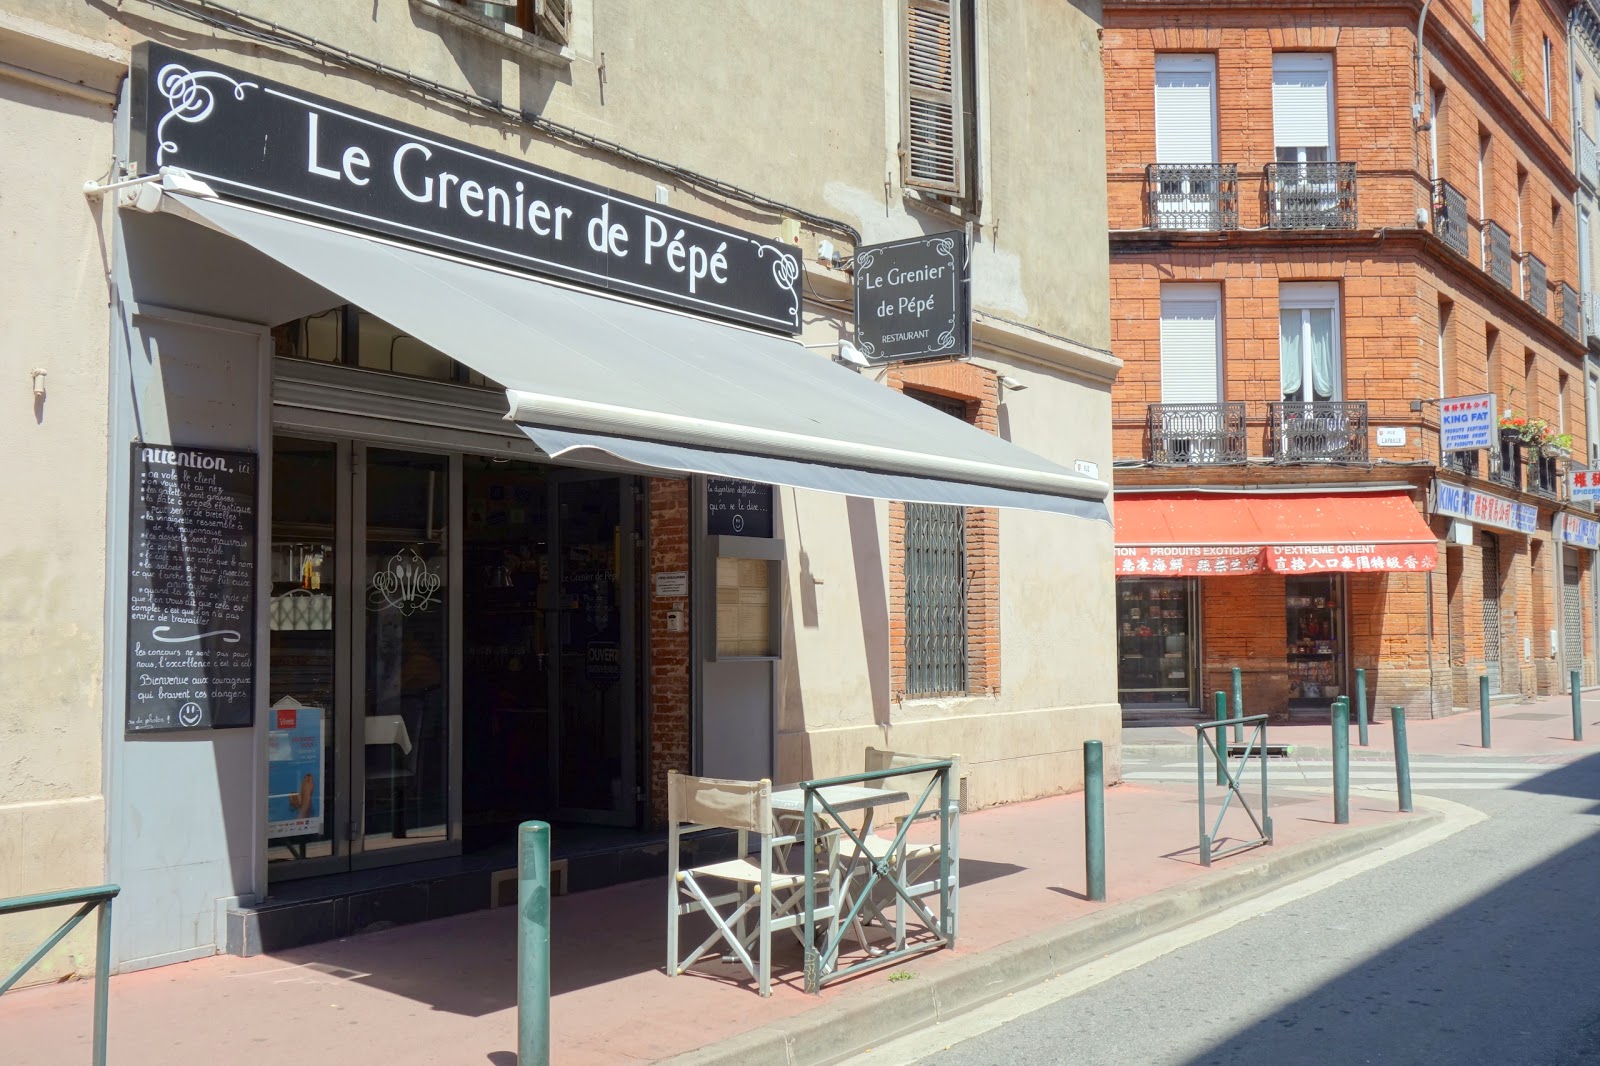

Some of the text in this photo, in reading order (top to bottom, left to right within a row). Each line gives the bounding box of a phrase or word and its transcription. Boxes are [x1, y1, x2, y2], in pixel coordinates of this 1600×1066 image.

[307, 113, 728, 293] Le Grenier de Pépé
[866, 265, 945, 289] Le Grenier
[877, 294, 934, 318] de Pépé
[882, 329, 929, 343] RESTAURANT
[1444, 412, 1488, 424] KING FAT
[161, 469, 177, 480] vole
[183, 470, 190, 482] le
[194, 471, 216, 484] client
[158, 487, 186, 498] galettes
[207, 493, 234, 502] grasses
[209, 486, 223, 495] nez
[709, 499, 726, 516] qu'on
[738, 498, 744, 510] le
[1439, 485, 1459, 512] KING
[1461, 490, 1475, 516] FAT
[146, 511, 154, 520] la
[156, 515, 193, 527] vinaigrette
[196, 518, 235, 529] ressemble
[170, 506, 191, 515] servir
[194, 508, 203, 517] de
[206, 510, 237, 520] bretelles
[152, 523, 222, 537] de la mayonnaise
[145, 531, 248, 547] les desserts sont mauvais
[158, 543, 178, 552] pichet
[182, 544, 224, 554] imbuvable
[1150, 547, 1201, 556] PRODUITS
[1203, 546, 1260, 556] EXOTIQUES
[1274, 546, 1334, 555] D'EXTREME
[1337, 545, 1376, 554] ORIENT
[144, 560, 249, 578] la salade est aux insectes
[186, 554, 194, 562] de
[216, 559, 228, 568] que
[239, 561, 253, 569] nom
[142, 571, 155, 579] que
[186, 573, 196, 582] de
[167, 581, 208, 590] animaux
[144, 587, 169, 597] quand
[172, 587, 181, 596] la
[184, 588, 205, 598] salle
[223, 593, 239, 602] vide
[131, 596, 145, 605] que
[166, 597, 183, 605] vous
[185, 597, 196, 607] dit
[198, 601, 212, 610] que
[215, 601, 230, 610] cela
[233, 604, 245, 612] est
[131, 604, 160, 615] complet
[164, 606, 180, 614] c'est
[182, 608, 194, 618] que
[226, 613, 240, 621] pas
[131, 612, 210, 626] envie de travailler
[195, 649, 211, 657] sont
[158, 656, 211, 668] l'excellence
[213, 659, 229, 667] c'est
[233, 659, 239, 667] à
[139, 673, 251, 689] Bienvenue aux courageux
[138, 686, 246, 704] qui bravent ces dangers
